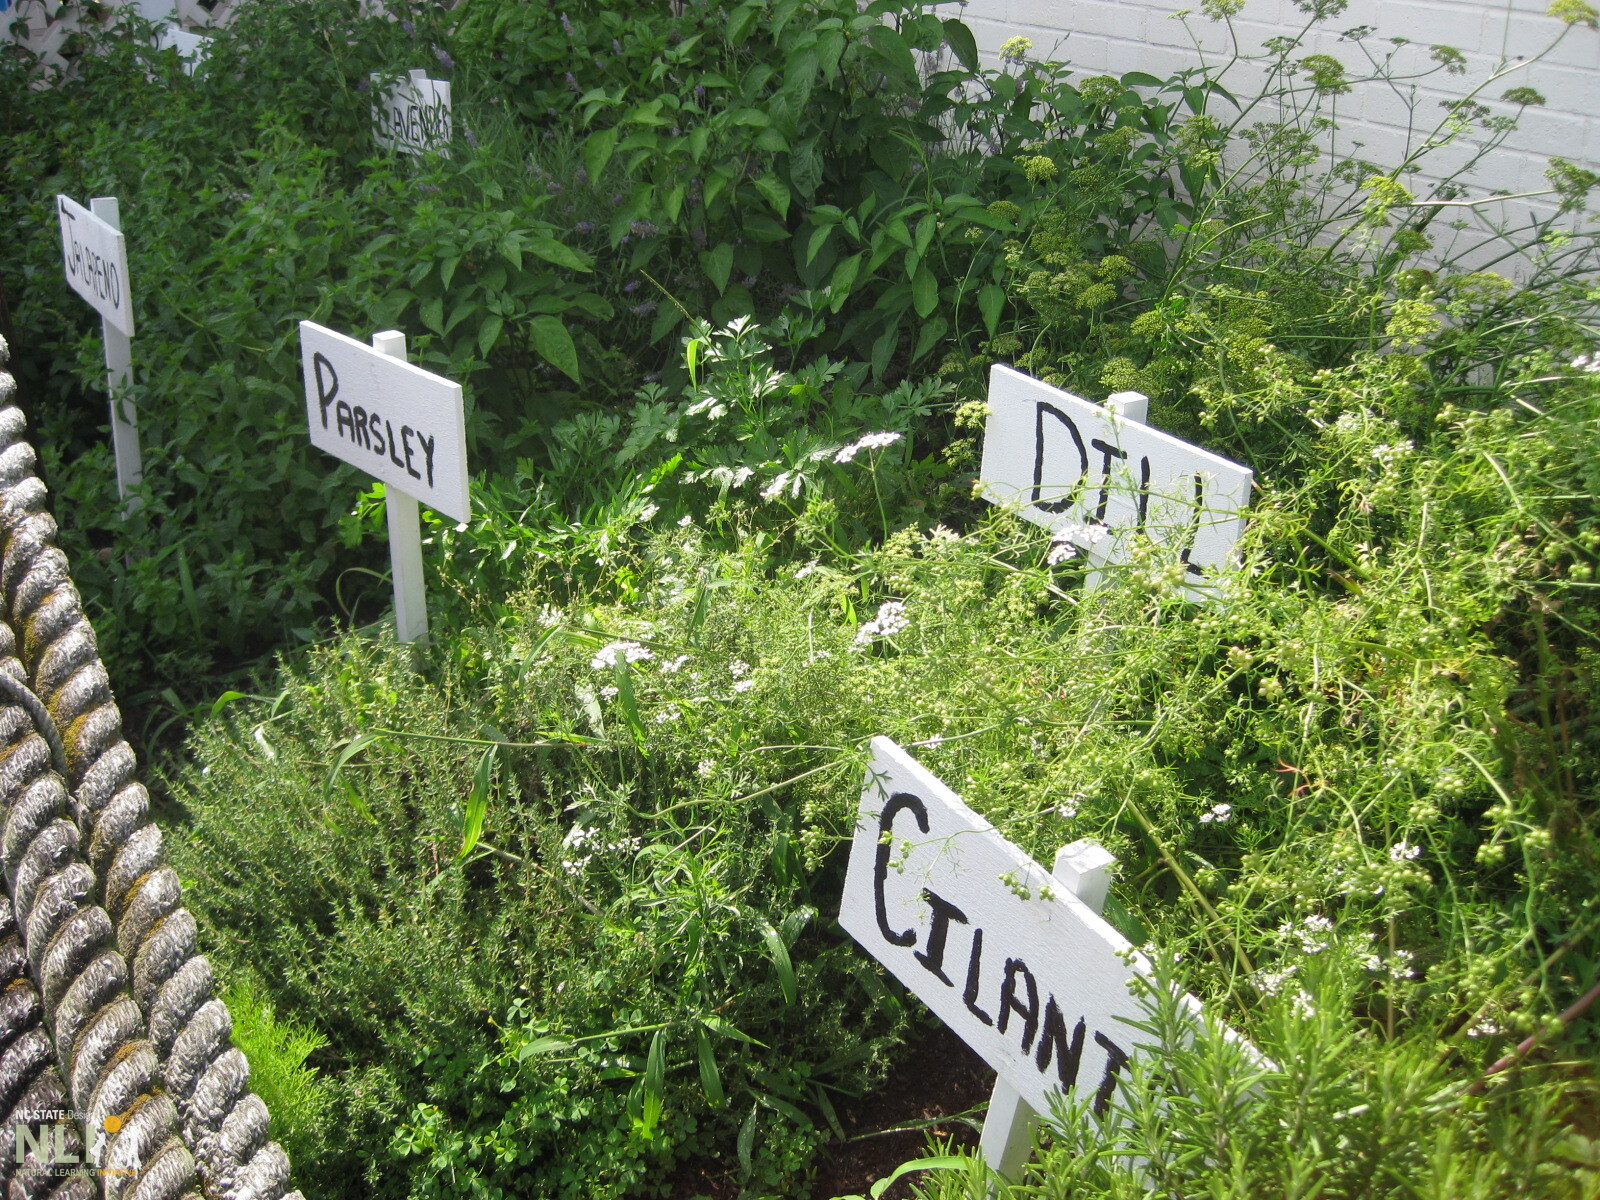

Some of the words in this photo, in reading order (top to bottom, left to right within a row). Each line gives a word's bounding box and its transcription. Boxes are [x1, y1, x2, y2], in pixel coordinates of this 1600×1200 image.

[313, 351, 435, 489] PARSLEY
[1030, 401, 1210, 580] DILL
[873, 792, 1160, 1140] CILANT
